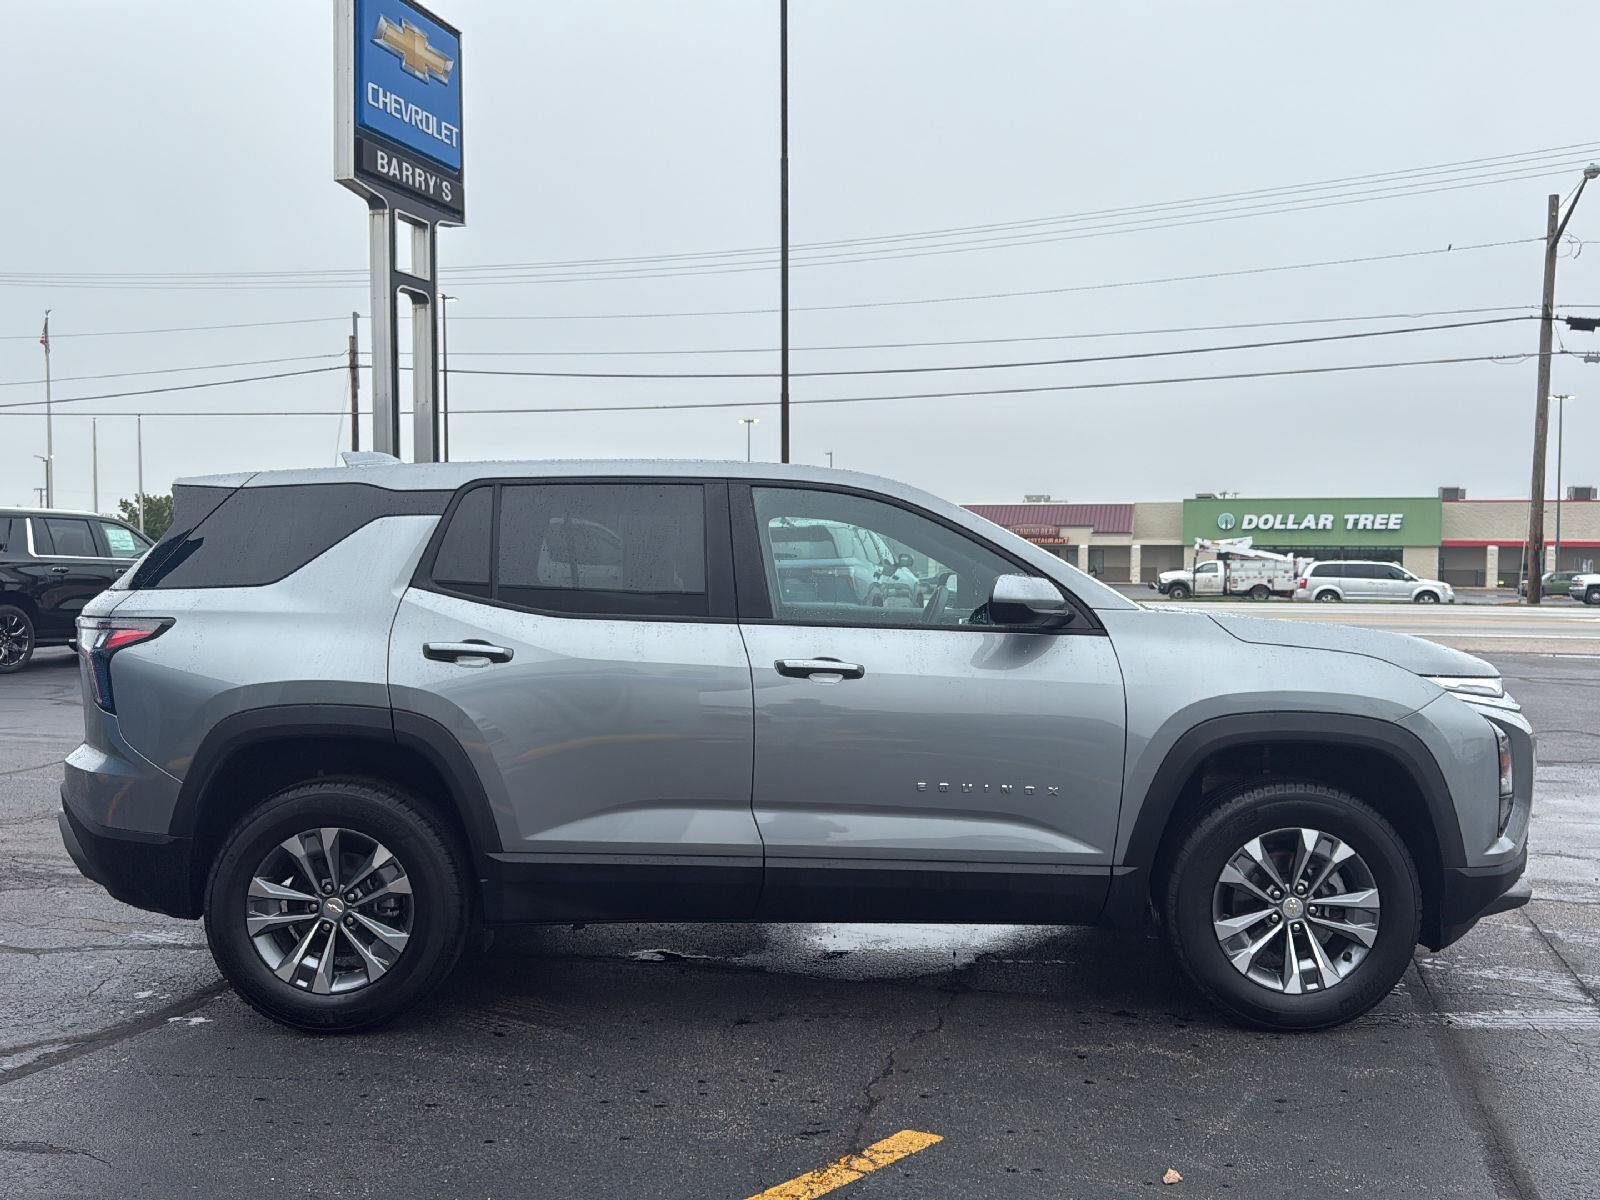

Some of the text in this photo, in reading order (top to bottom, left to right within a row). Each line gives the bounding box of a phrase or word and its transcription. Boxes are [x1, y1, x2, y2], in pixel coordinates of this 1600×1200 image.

[367, 81, 459, 147] CHEVROLET
[377, 150, 452, 201] BARRY'S
[1241, 513, 1403, 530] DOLLAR TREE
[917, 782, 1059, 796] EQUINOX
